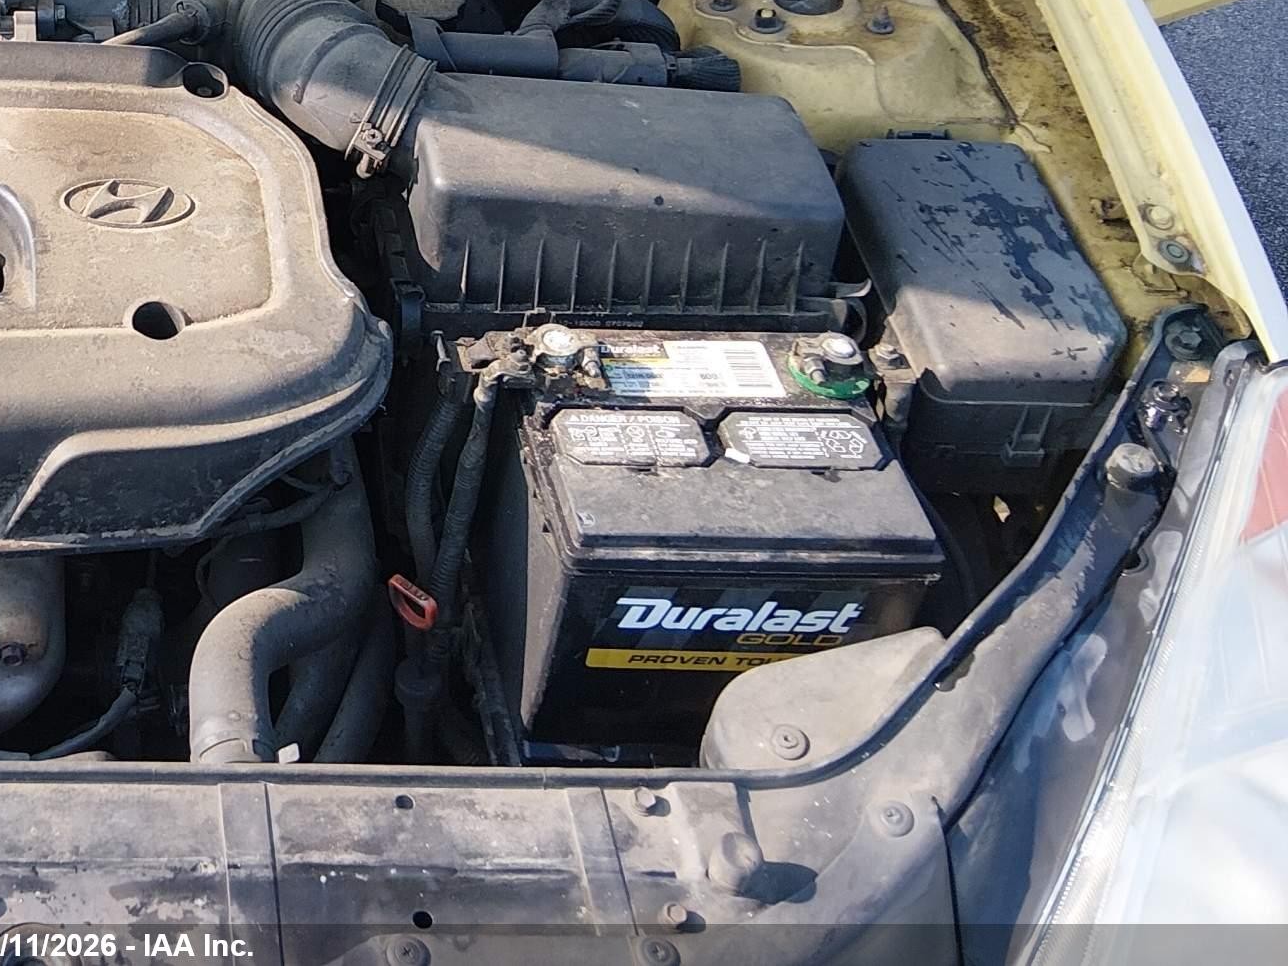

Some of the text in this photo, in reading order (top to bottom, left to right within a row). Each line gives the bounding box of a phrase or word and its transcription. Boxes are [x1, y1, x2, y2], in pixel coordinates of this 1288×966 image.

[600, 342, 661, 354] Duralast
[580, 415, 627, 423] DANGER
[616, 597, 862, 634] Duralast
[736, 633, 843, 646] GOLD
[628, 654, 728, 666] PROVEN
